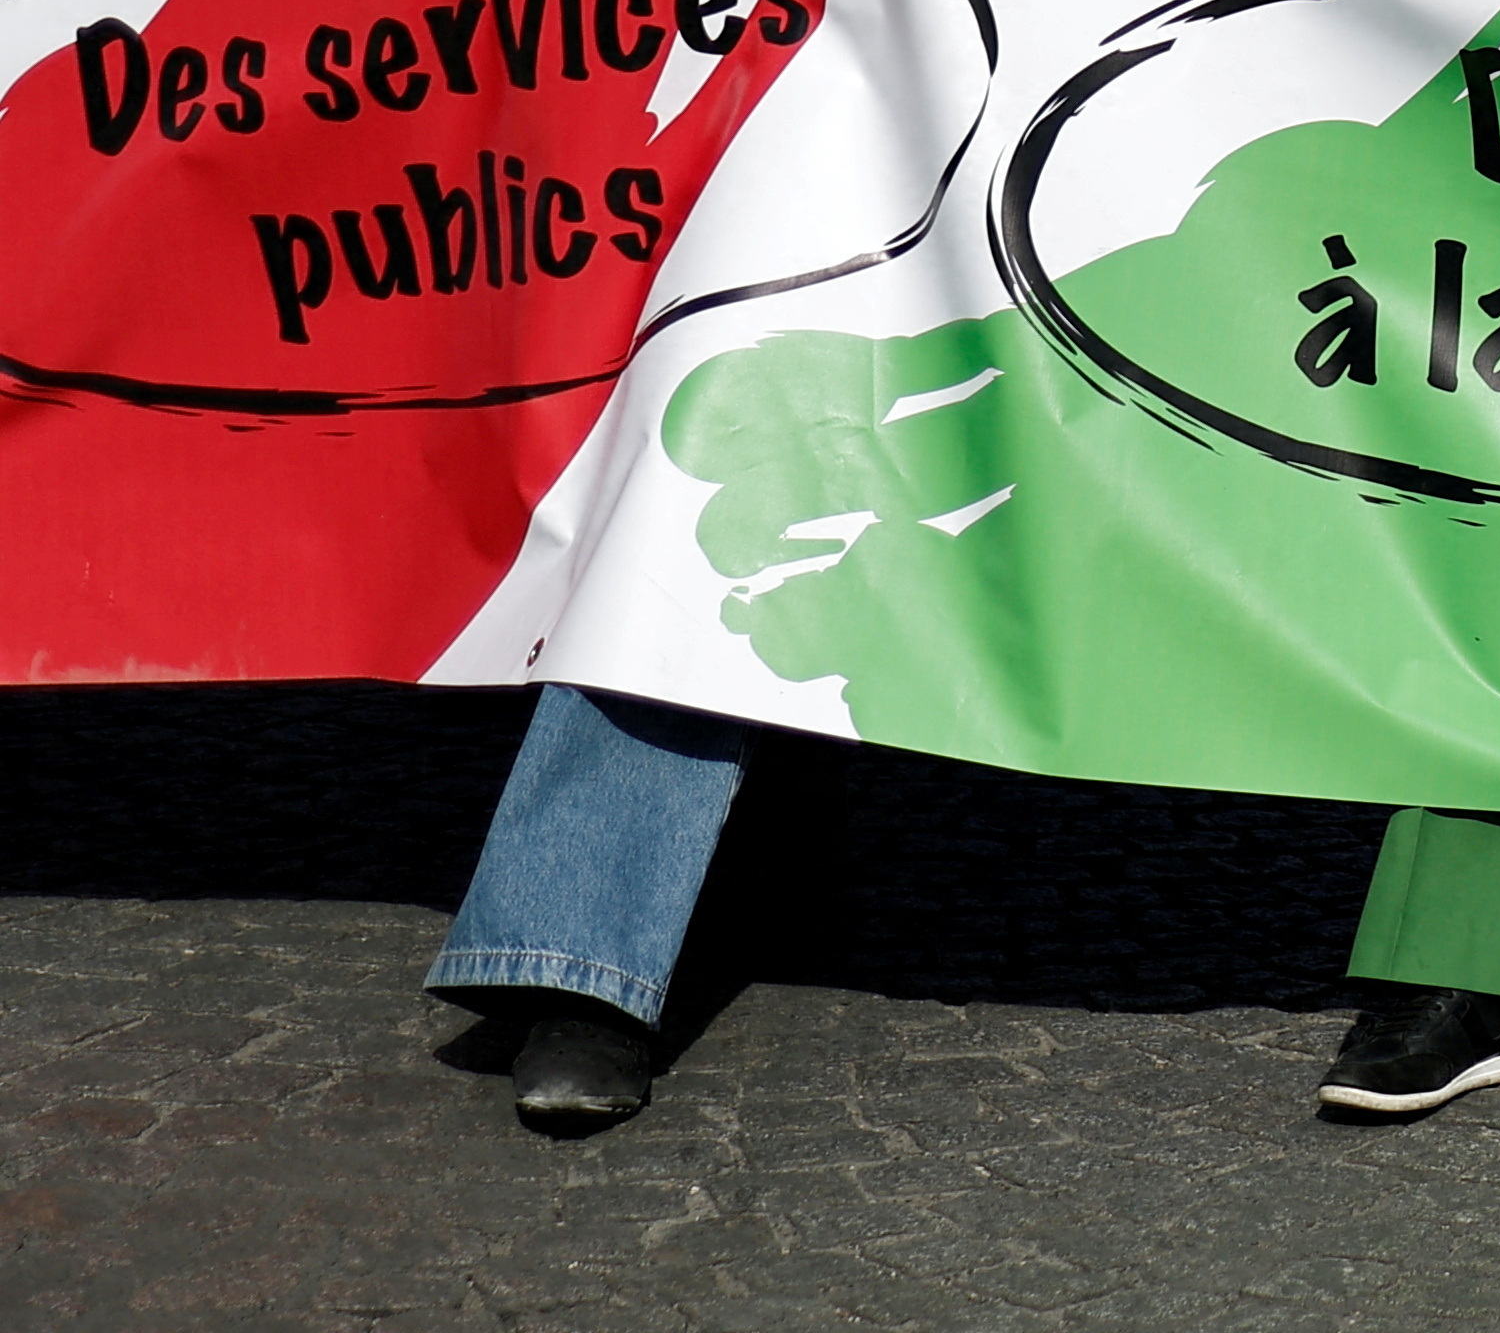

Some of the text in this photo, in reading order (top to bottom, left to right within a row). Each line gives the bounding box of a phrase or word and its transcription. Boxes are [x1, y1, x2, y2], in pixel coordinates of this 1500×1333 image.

[77, 17, 267, 156] Des
[250, 149, 664, 344] publics
[1294, 234, 1378, 388] à
